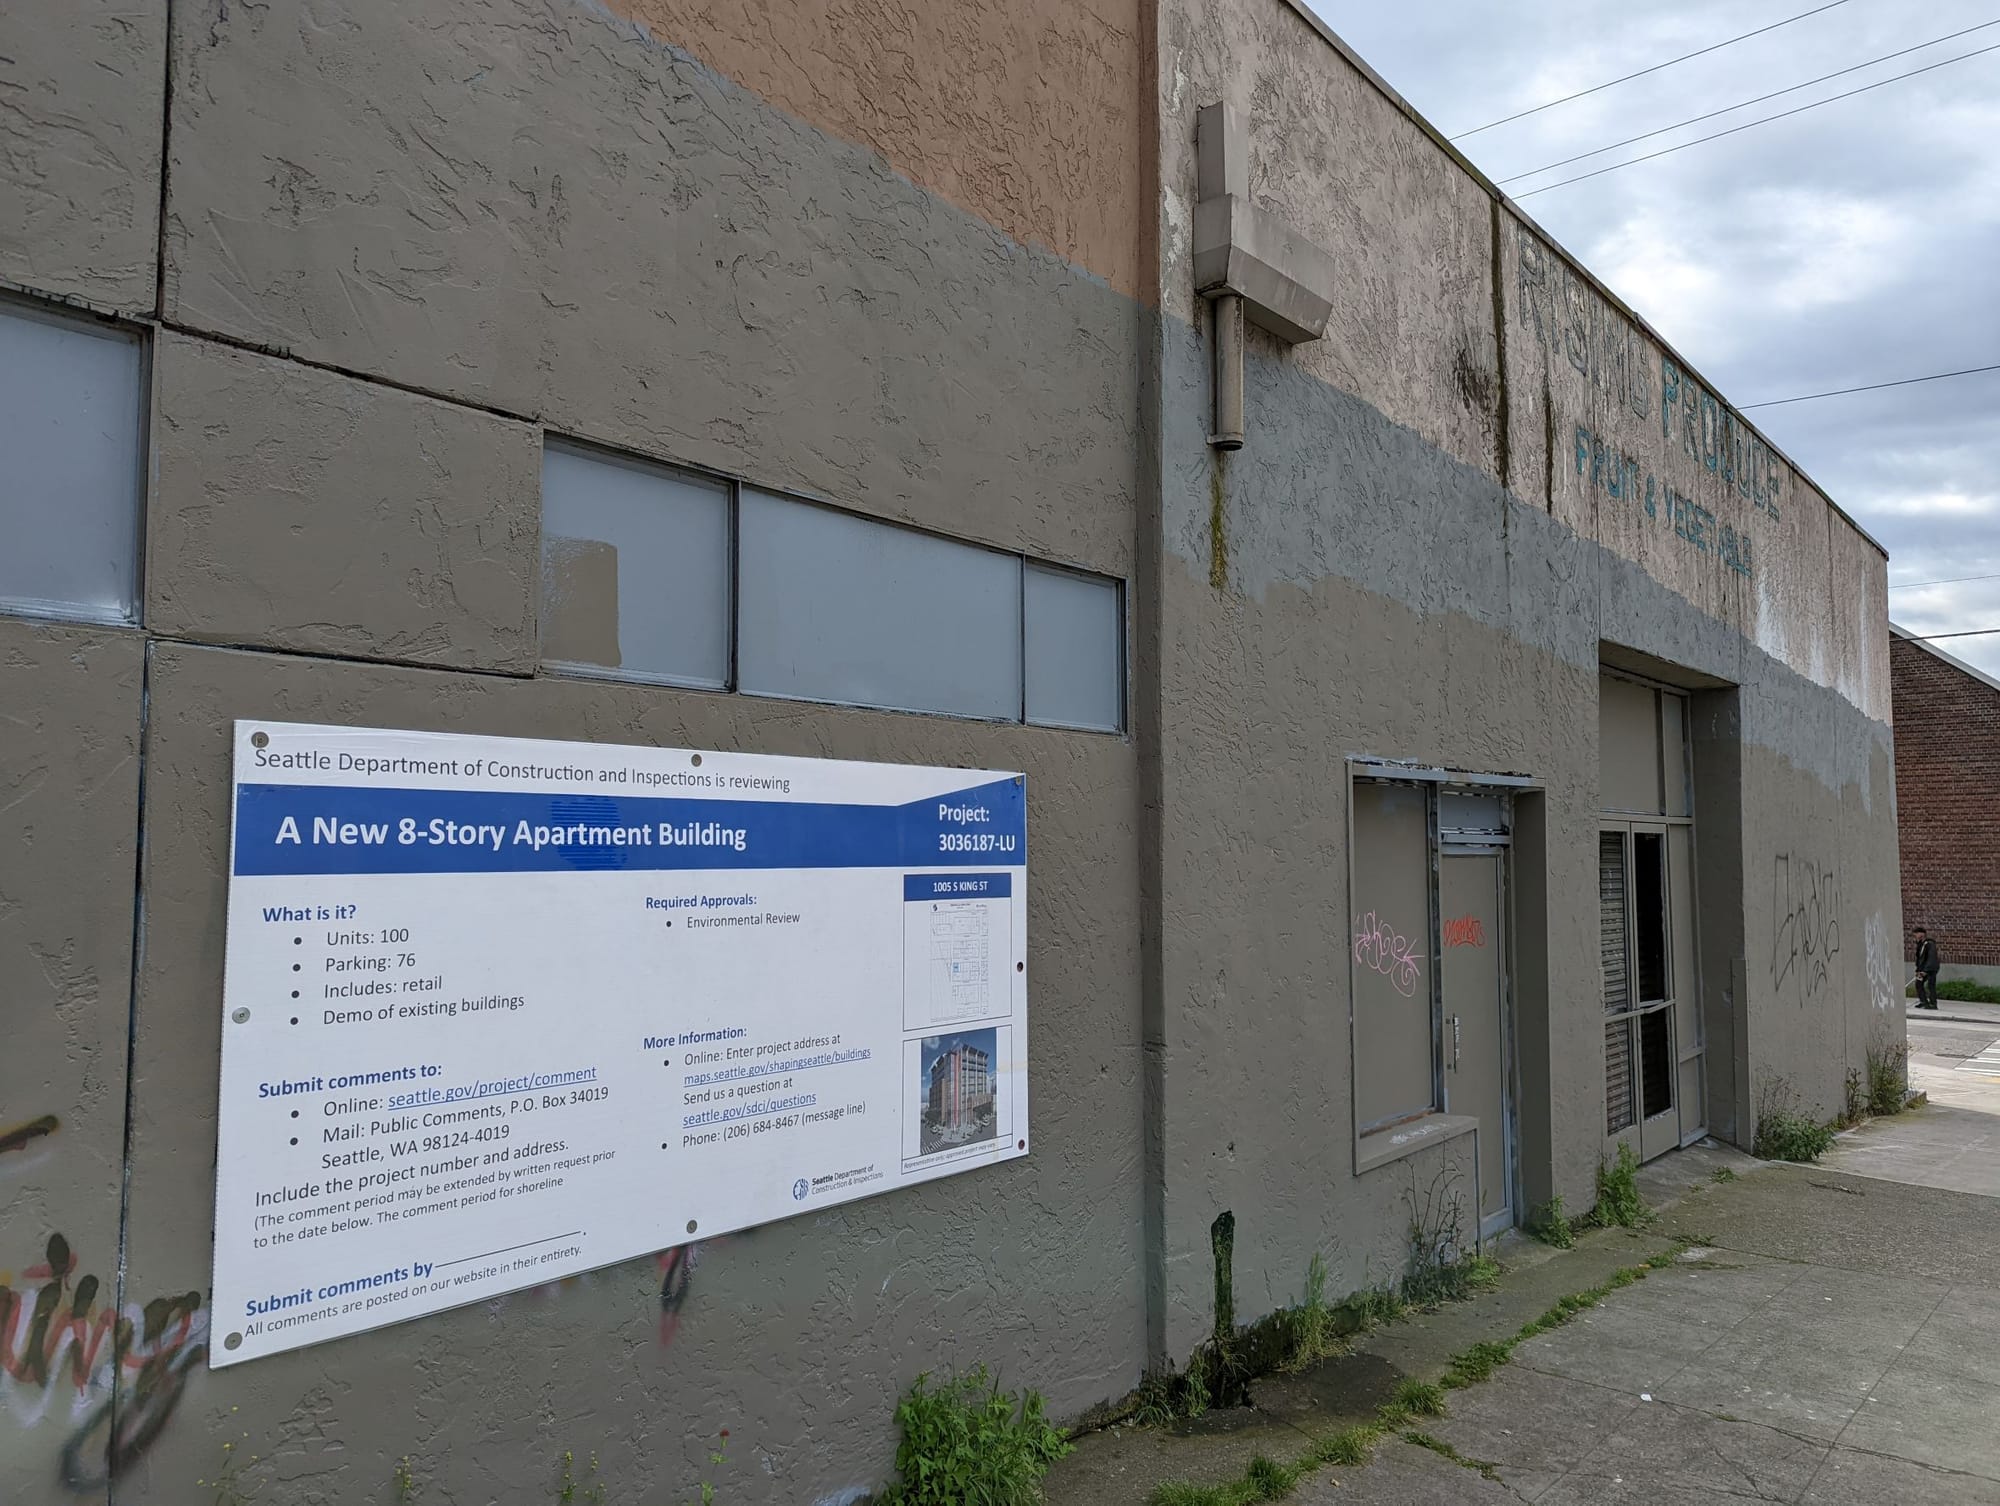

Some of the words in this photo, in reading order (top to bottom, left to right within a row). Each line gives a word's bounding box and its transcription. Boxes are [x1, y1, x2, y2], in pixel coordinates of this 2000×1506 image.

[1662, 356, 1779, 522] PRODUCE
[1576, 426, 1639, 501] FRUIT
[255, 749, 331, 769] Seattle
[338, 752, 458, 777] Department
[464, 759, 483, 777] of
[487, 761, 593, 782] Construction
[599, 766, 627, 783] and
[632, 770, 710, 788] Inspections
[715, 775, 725, 788] is
[729, 776, 790, 792] reviewing
[939, 804, 990, 824] Project:
[275, 817, 301, 844] A
[313, 817, 388, 844] New
[398, 819, 506, 850] 8-Story
[513, 821, 652, 850] Apartment
[659, 823, 747, 851] Building
[939, 835, 1015, 851] 3036187-LU
[646, 897, 697, 910] Required
[700, 894, 757, 909] Approvals:
[933, 882, 951, 892] 1005
[953, 882, 958, 892] S
[960, 882, 978, 892] KING
[979, 881, 988, 891] ST
[263, 906, 311, 922] What
[317, 907, 330, 920] is
[335, 904, 356, 920] it?
[687, 914, 762, 928] Environmental
[766, 913, 800, 924] Review
[327, 930, 375, 946] Units:
[380, 928, 409, 943] 100
[326, 956, 391, 973] Parking:
[397, 954, 416, 967] 76
[324, 981, 397, 998] Includes:
[402, 976, 442, 992] retail
[323, 1008, 373, 1025] Demo
[378, 1005, 394, 1019] of
[399, 1000, 457, 1018] existing
[462, 995, 524, 1012] buildings
[643, 1037, 675, 1049] More
[679, 1027, 747, 1045] Information:
[685, 1052, 723, 1066] Online:
[726, 1047, 753, 1060] Enter
[757, 1042, 791, 1058] project
[794, 1035, 829, 1050] address
[832, 1035, 840, 1044] at
[258, 1078, 323, 1098] Submit
[328, 1066, 416, 1090] comments
[420, 1063, 442, 1077] to:
[684, 1047, 871, 1085] maps.seattle.gov/shapingseattle/buildings
[324, 1097, 384, 1117] Online:
[388, 1066, 597, 1109] seattle.gov/project/comment
[684, 1090, 710, 1105] Send
[714, 1088, 725, 1100] us
[728, 1088, 734, 1098] a
[737, 1079, 780, 1096] question
[783, 1078, 793, 1088] at
[323, 1124, 366, 1143] Mail:
[371, 1117, 418, 1136] Public
[422, 1105, 505, 1128] Comments,
[510, 1099, 538, 1114] P.O.
[542, 1094, 566, 1109] Box
[570, 1087, 609, 1104] 34019
[683, 1092, 816, 1126] seattle.gov/sdci/questions
[683, 1130, 720, 1147] Phone:
[723, 1122, 750, 1142] (206)
[753, 1114, 799, 1134] 684-8467
[802, 1109, 844, 1127] (message
[846, 1101, 865, 1116] line)
[322, 1149, 384, 1169] Seattle,
[390, 1141, 418, 1156] WA
[423, 1125, 510, 1152] 98124-4019
[256, 1184, 320, 1207] Include
[325, 1177, 353, 1195] the
[358, 1166, 415, 1190] project
[420, 1154, 478, 1176] number
[483, 1149, 509, 1165] and
[513, 1138, 569, 1161] address.
[811, 1180, 847, 1195] Construction
[853, 1171, 884, 1186] Inspections
[812, 1175, 833, 1186] Seattle
[834, 1166, 866, 1181] Department
[868, 1165, 873, 1173] of
[255, 1214, 284, 1231] (The
[288, 1200, 351, 1222] comment
[354, 1191, 394, 1213] period
[397, 1187, 424, 1204] may
[426, 1183, 440, 1196] be
[443, 1172, 495, 1193] extended
[498, 1169, 511, 1183] by
[514, 1162, 550, 1179] written
[554, 1154, 590, 1174] request
[592, 1149, 616, 1166] prior
[254, 1236, 268, 1248] to
[272, 1230, 294, 1245] the
[298, 1223, 327, 1240] date
[331, 1215, 372, 1234] below.
[377, 1209, 399, 1224] The
[402, 1197, 458, 1219] comment
[461, 1188, 496, 1208] period
[499, 1184, 513, 1198] for
[516, 1176, 563, 1195] shoreline
[245, 1320, 263, 1338] All
[267, 1305, 338, 1332] comments
[342, 1299, 362, 1313] are
[366, 1288, 408, 1310] posted
[412, 1284, 427, 1297] on
[430, 1278, 450, 1291] our
[453, 1266, 497, 1287] website
[500, 1262, 510, 1273] in
[513, 1255, 538, 1272] their
[540, 1245, 582, 1265] entirety.
[246, 1288, 312, 1316] Submit
[318, 1268, 408, 1300] comments
[413, 1261, 433, 1281] by
